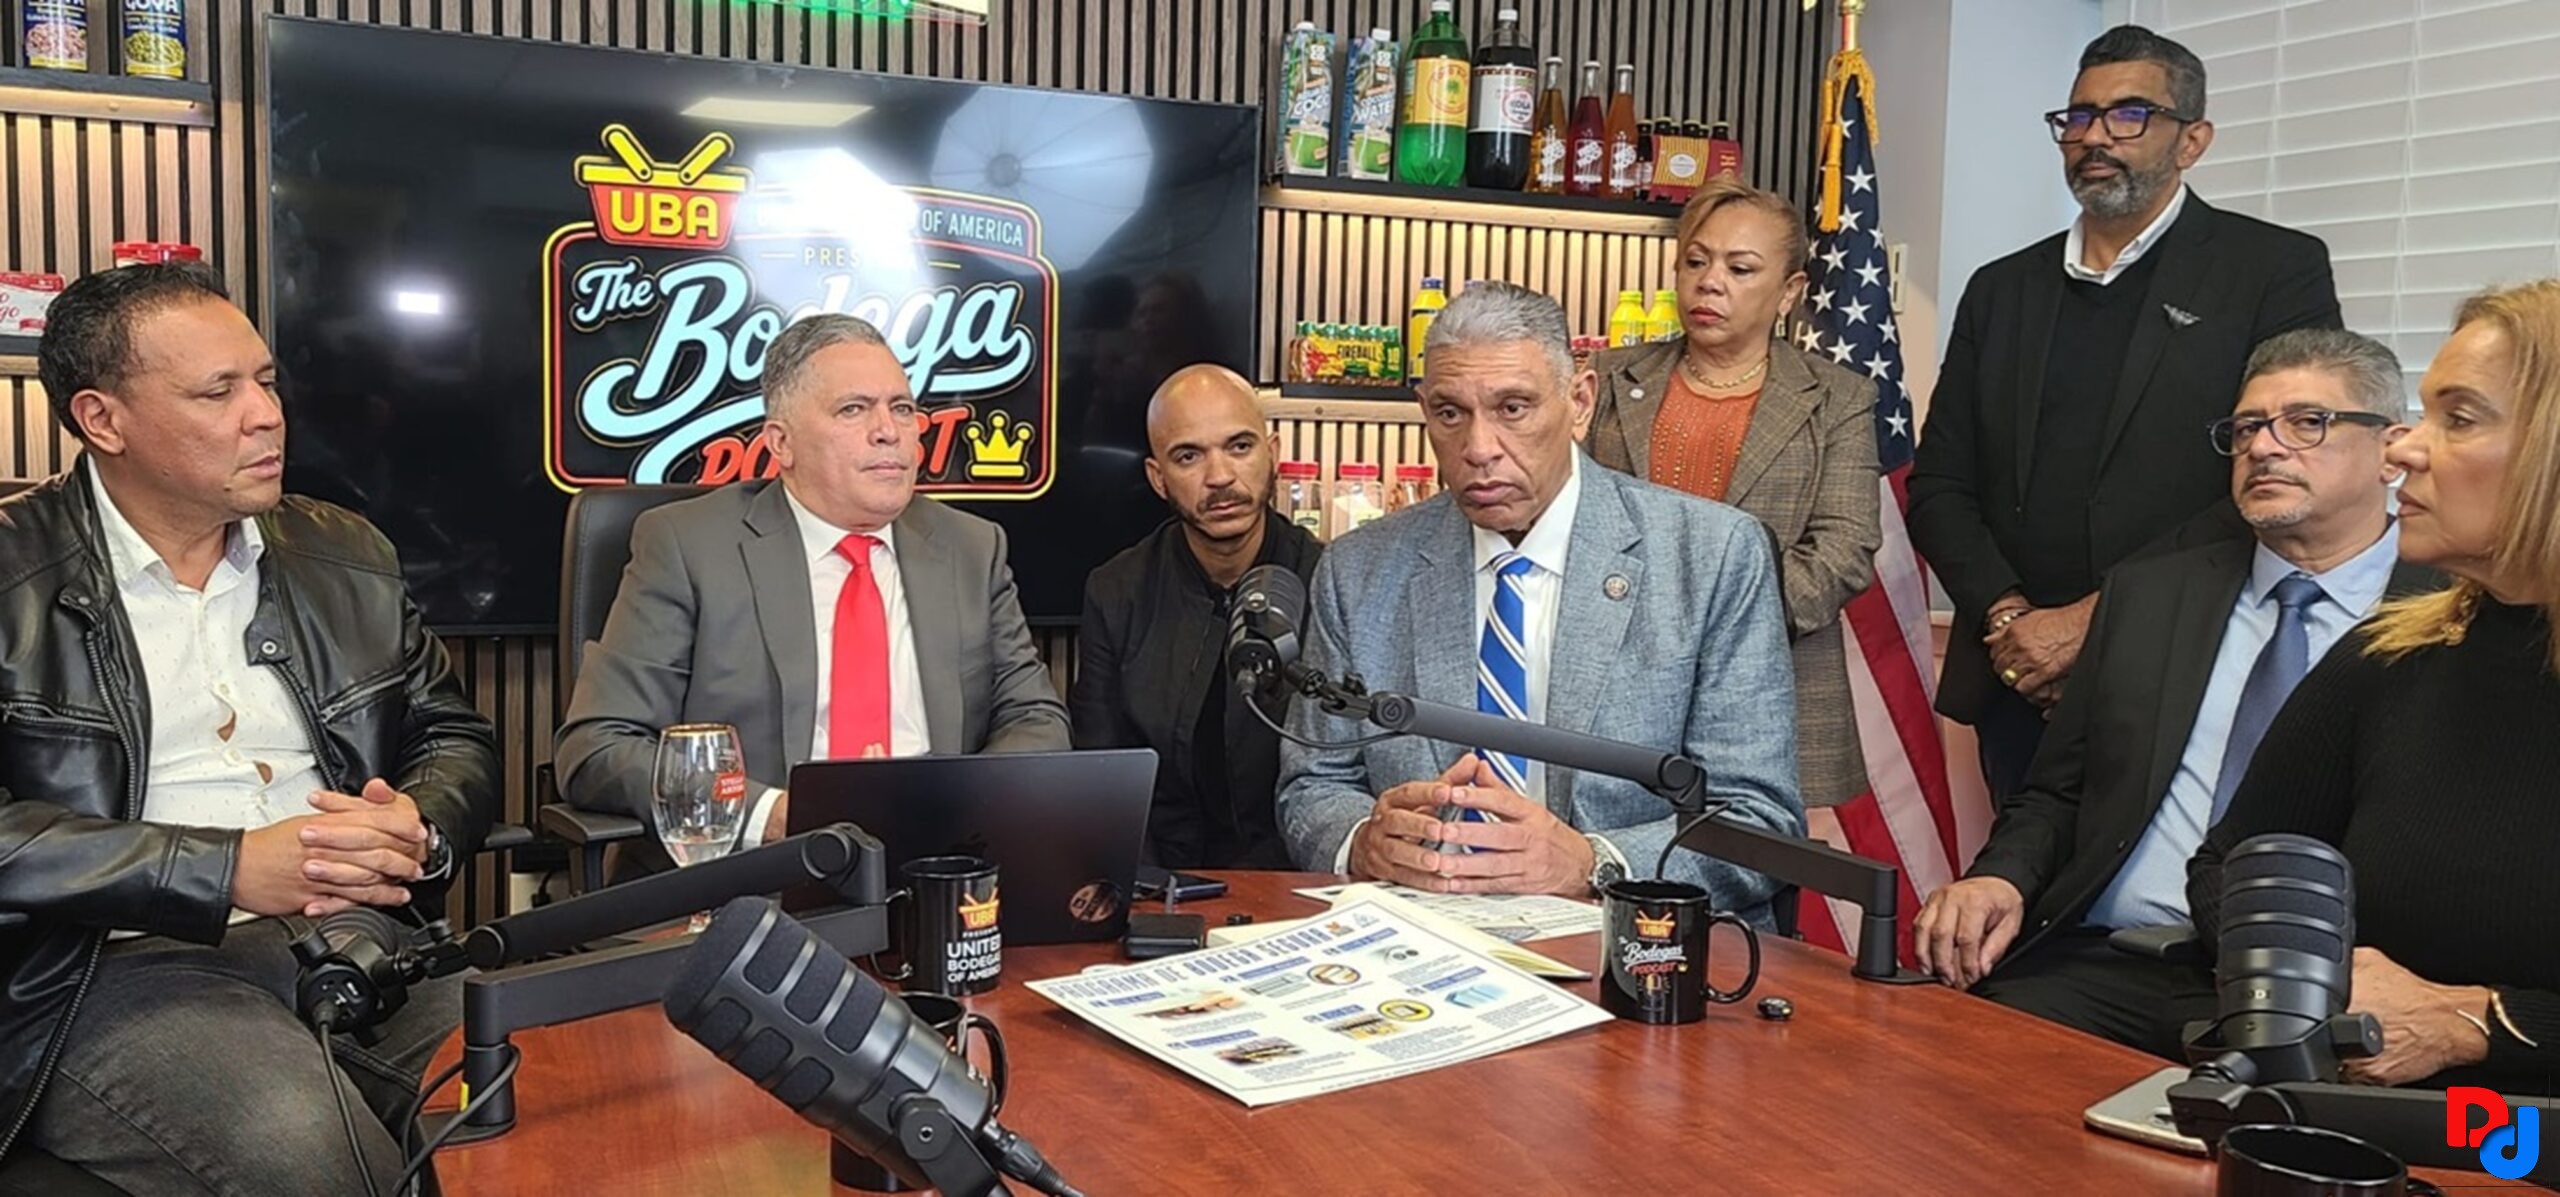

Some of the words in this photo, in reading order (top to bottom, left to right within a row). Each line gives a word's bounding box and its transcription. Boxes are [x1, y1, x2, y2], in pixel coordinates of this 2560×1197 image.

[608, 189, 719, 239] UBA
[921, 208, 944, 234] OF
[947, 212, 1024, 248] AMERICA
[575, 261, 655, 322] The
